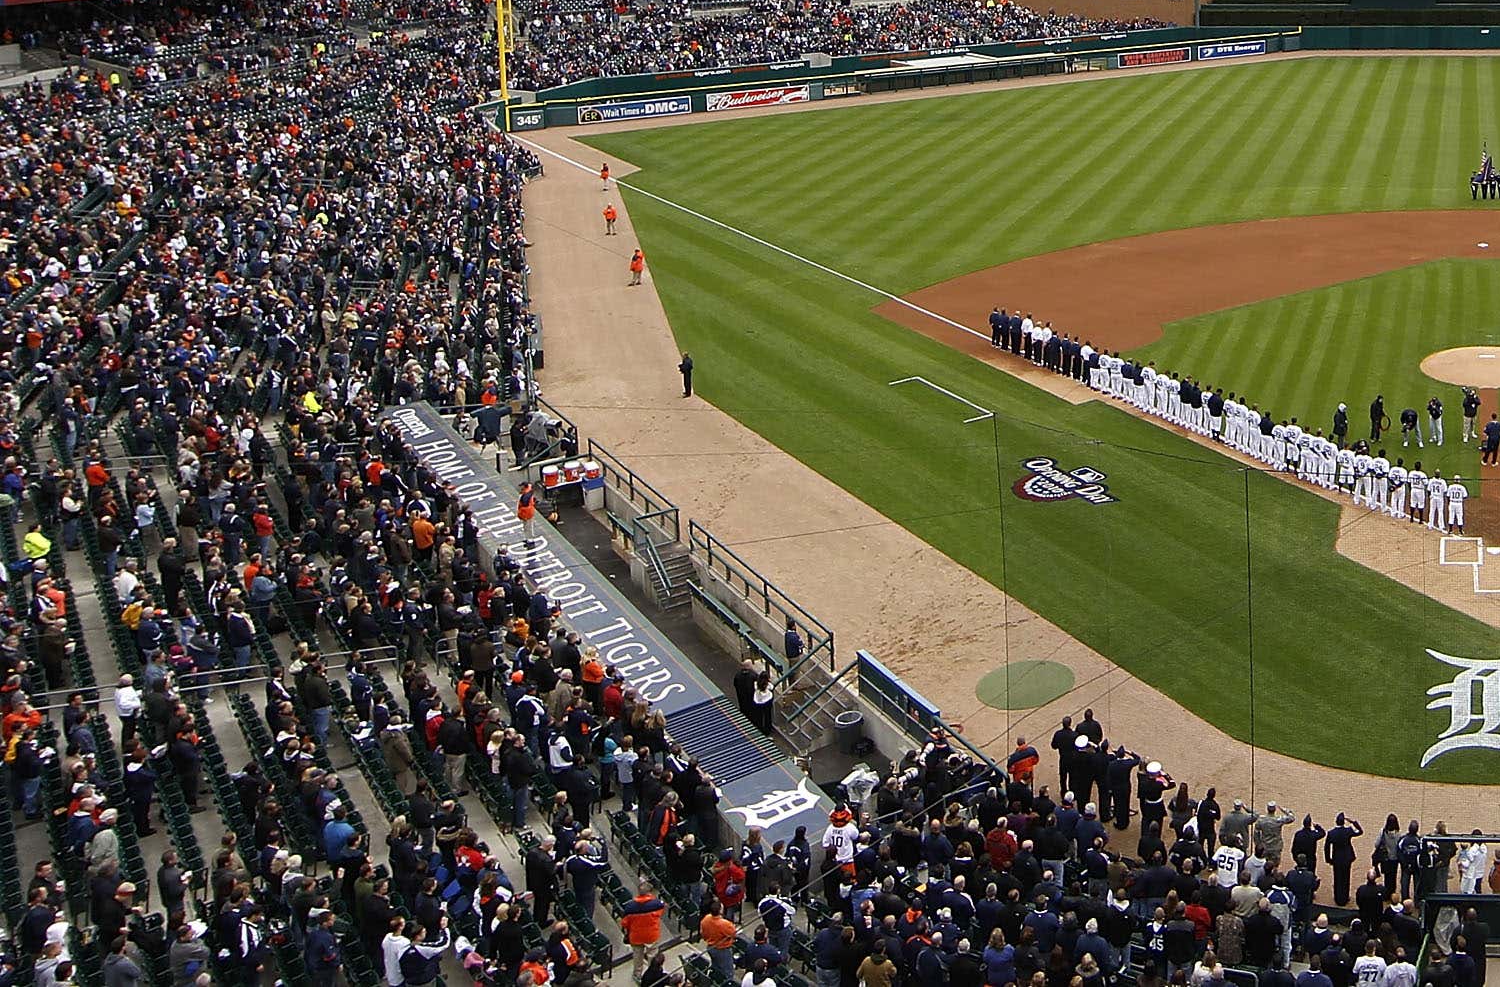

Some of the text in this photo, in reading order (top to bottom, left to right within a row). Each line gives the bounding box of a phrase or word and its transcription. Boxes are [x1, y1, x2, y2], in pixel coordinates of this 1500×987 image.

[1217, 44, 1261, 53] DTE Energy
[719, 89, 785, 110] Budweiser
[584, 112, 597, 121] ER
[603, 108, 620, 118] Wait
[621, 107, 640, 117] Times
[417, 438, 476, 485] HOME
[455, 481, 498, 505] OF
[475, 502, 527, 541] THE
[507, 536, 608, 621] DETROIT
[596, 617, 686, 704] TIGERS
[832, 835, 843, 847] 10
[1219, 854, 1235, 872] 25
[1150, 938, 1164, 951] 45
[1361, 971, 1378, 982] 77
